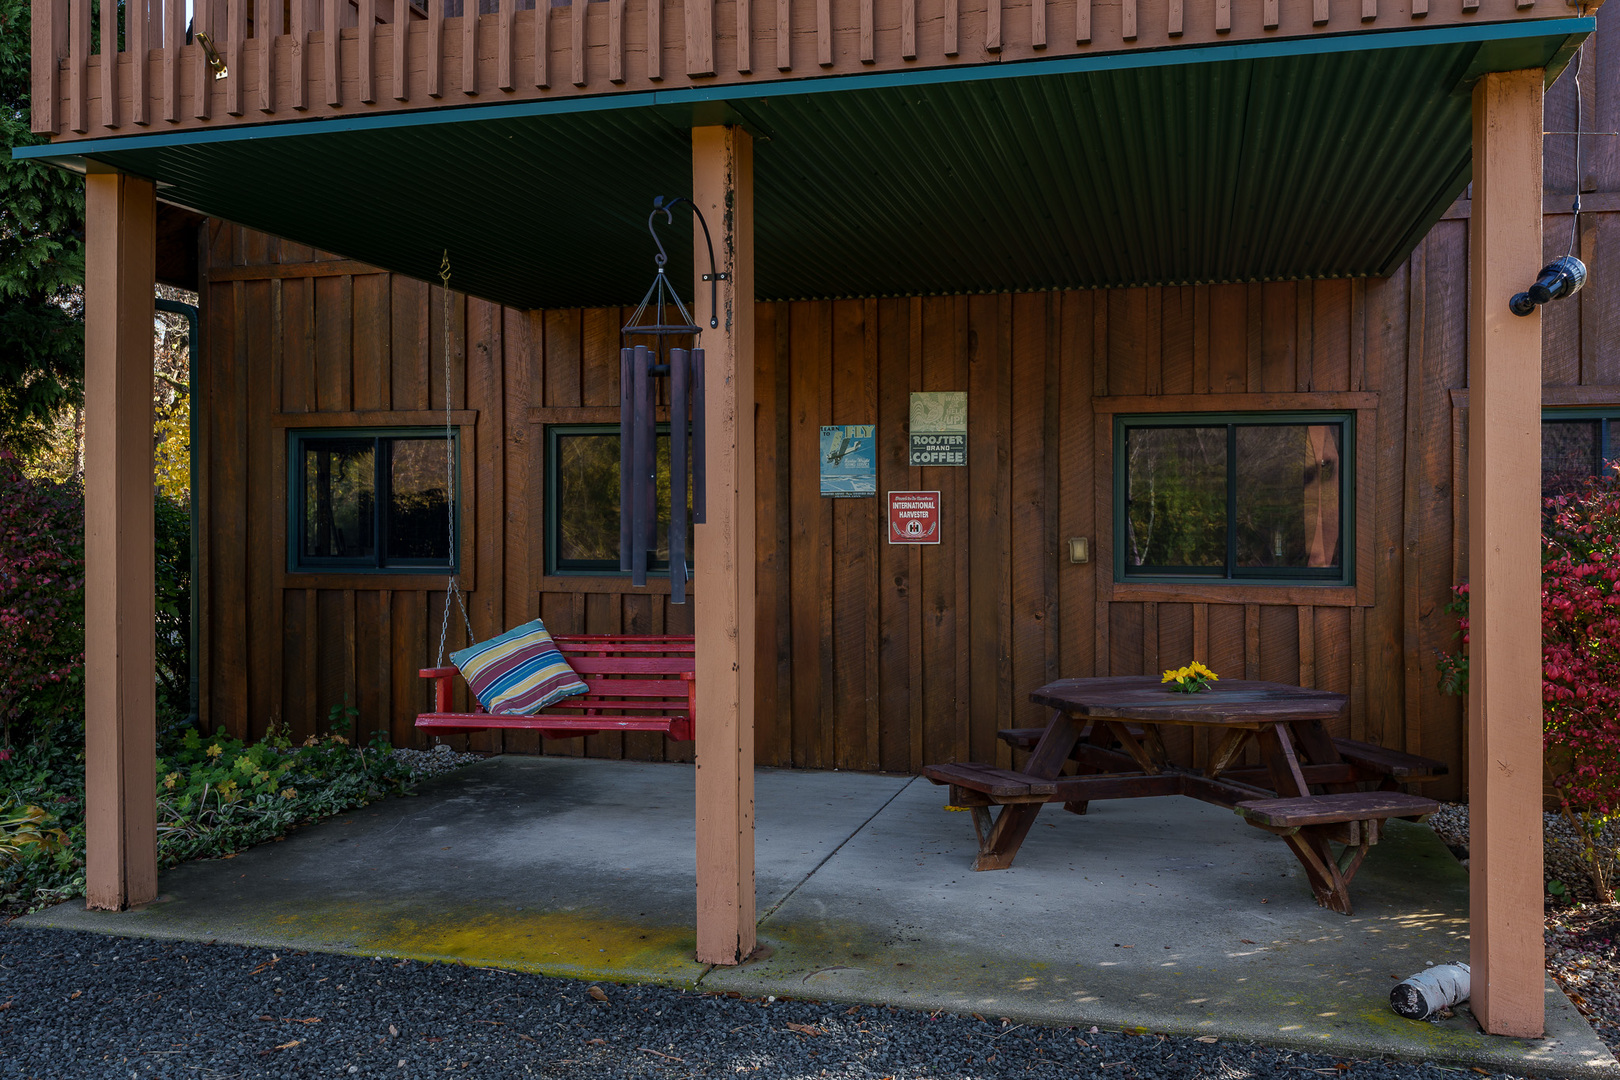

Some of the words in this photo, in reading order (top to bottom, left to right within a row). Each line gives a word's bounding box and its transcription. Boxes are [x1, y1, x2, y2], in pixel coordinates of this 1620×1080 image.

[946, 415, 963, 424] UP!
[845, 425, 875, 438] FLY
[913, 436, 963, 444] ROOSTER
[913, 452, 963, 462] COFFEE
